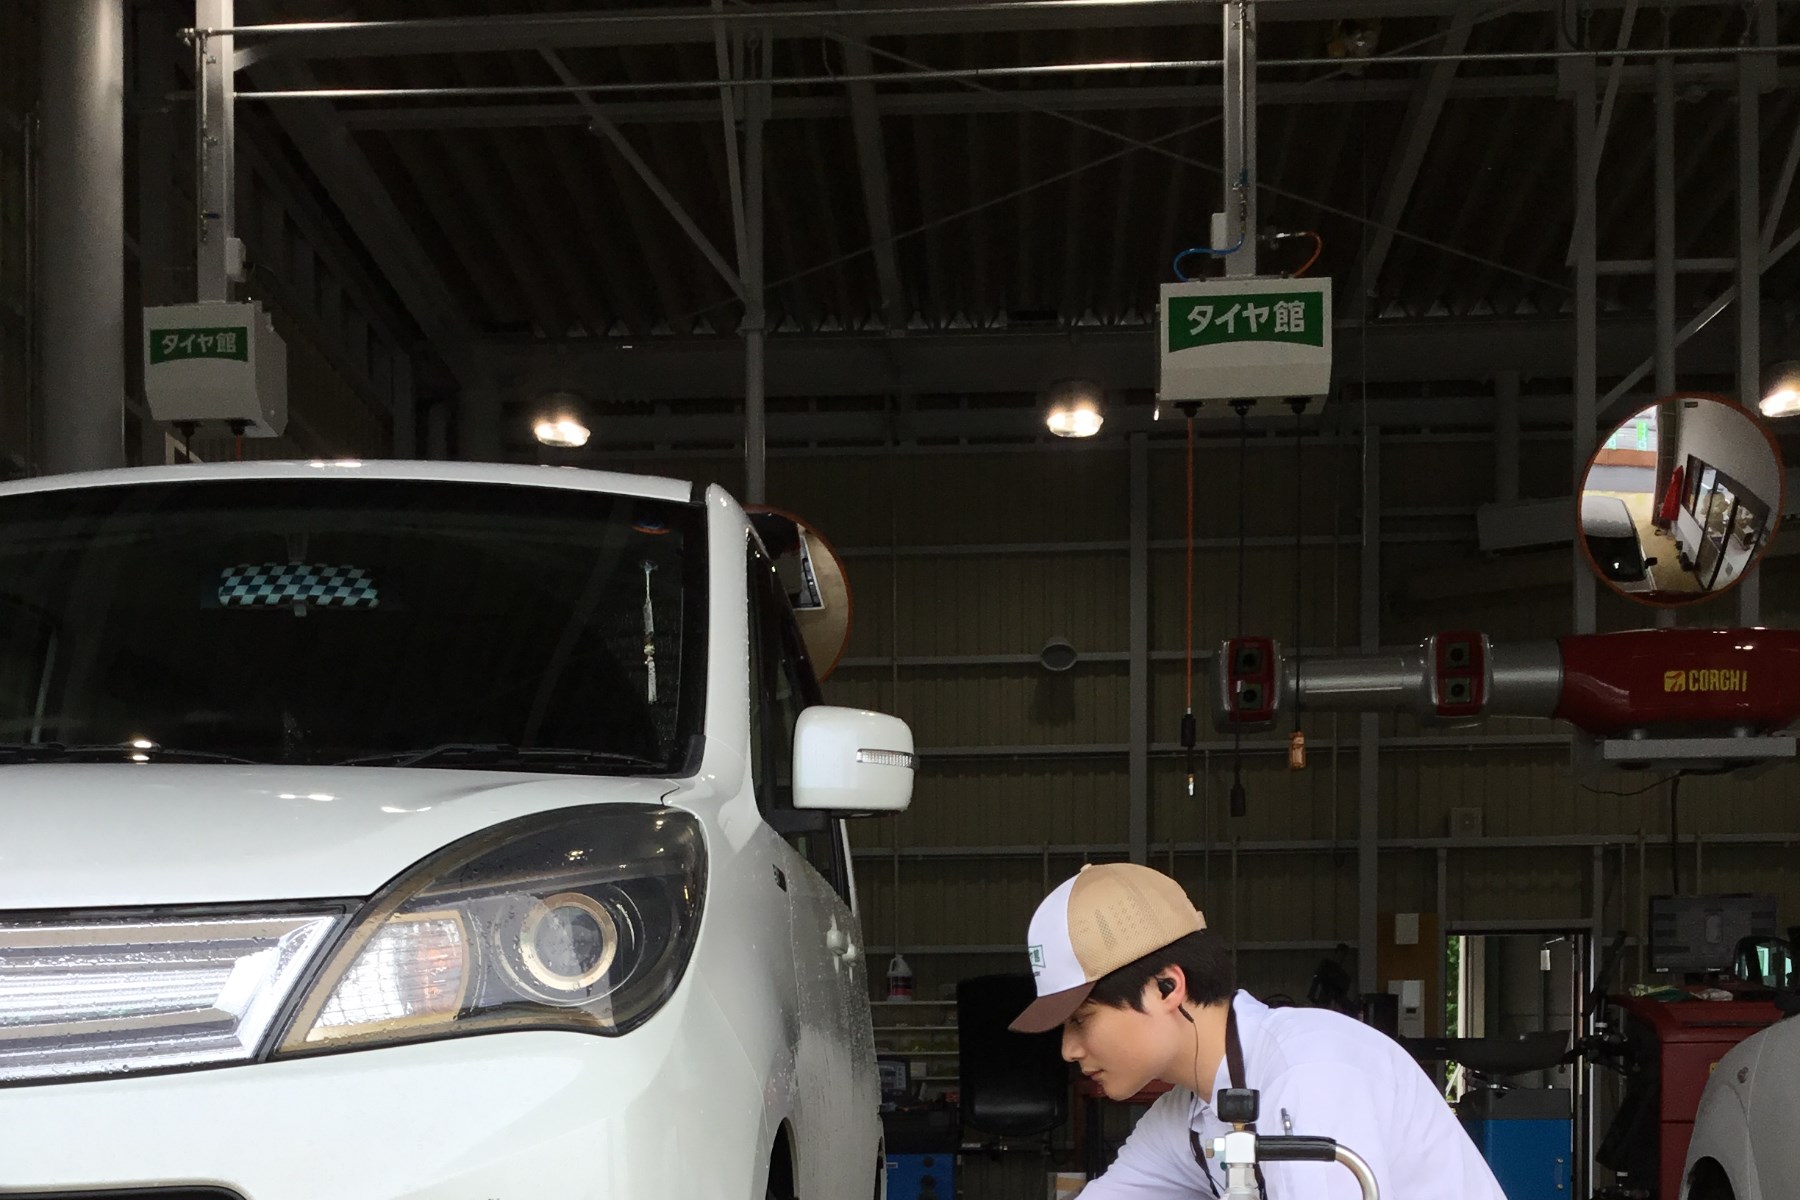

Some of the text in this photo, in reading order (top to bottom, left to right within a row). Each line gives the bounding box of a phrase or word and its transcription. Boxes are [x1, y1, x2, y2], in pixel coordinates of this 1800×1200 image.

[1187, 300, 1305, 336] タイヤ館
[162, 332, 237, 354] タイヤ館
[1689, 669, 1748, 692] CORGHI
